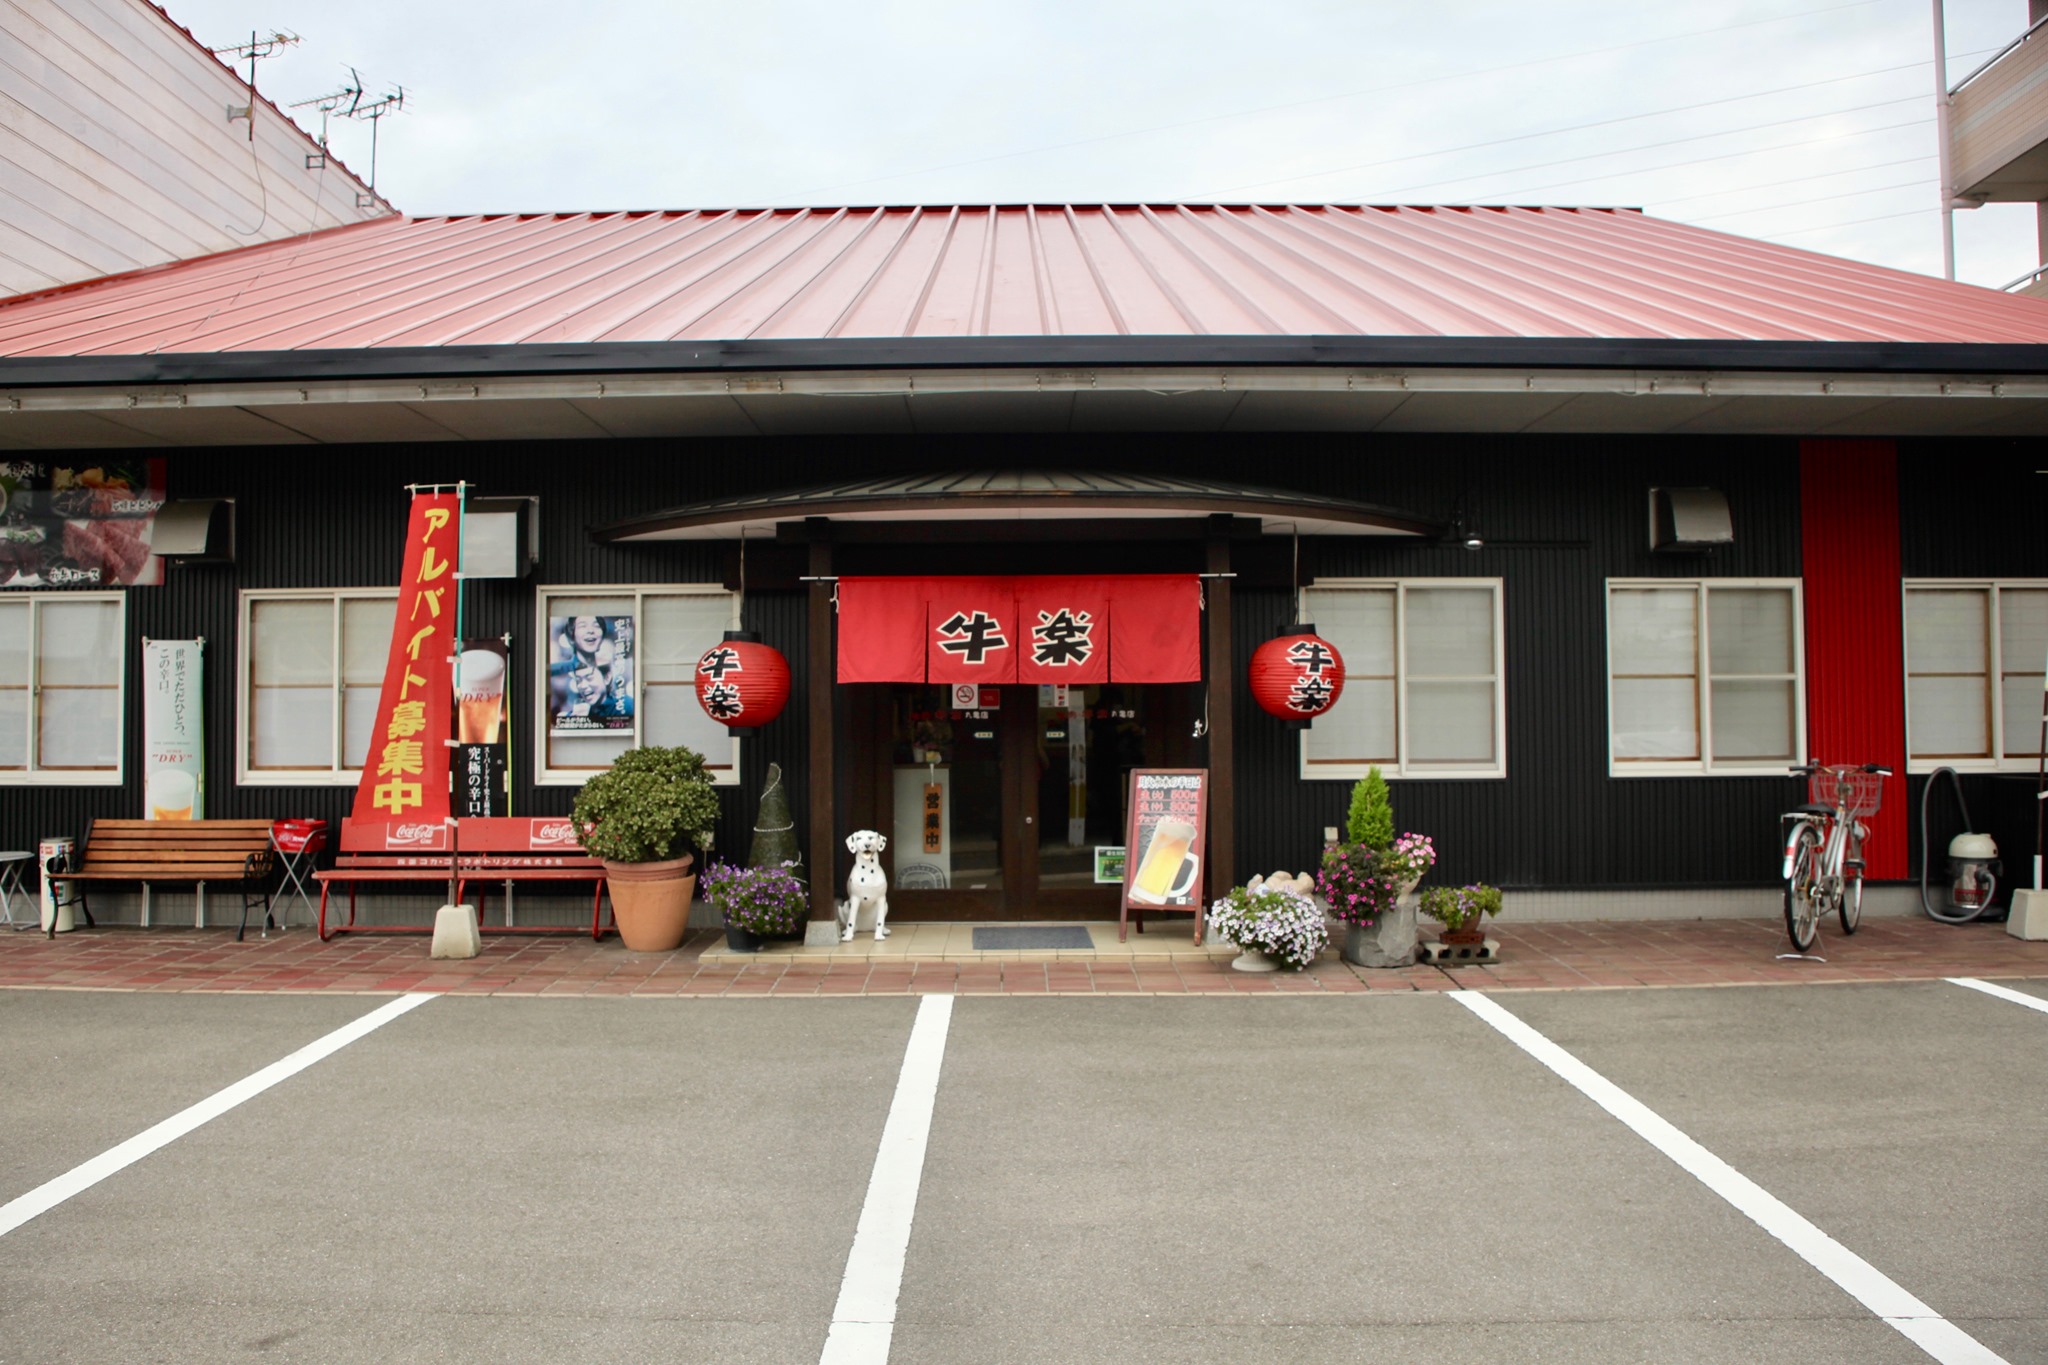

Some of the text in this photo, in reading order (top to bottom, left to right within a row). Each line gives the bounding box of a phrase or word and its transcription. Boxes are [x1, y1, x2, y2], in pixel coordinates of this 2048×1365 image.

[373, 507, 450, 816] アルバイト募集中
[936, 608, 1094, 667] 牛楽
[159, 649, 170, 694] この辛口。
[174, 649, 186, 736] 世界でただひとつ、
[698, 648, 746, 720] 牛楽
[1284, 641, 1336, 713] 牛楽
[396, 824, 434, 838] Coca-Cola
[926, 792, 940, 848] 営業中
